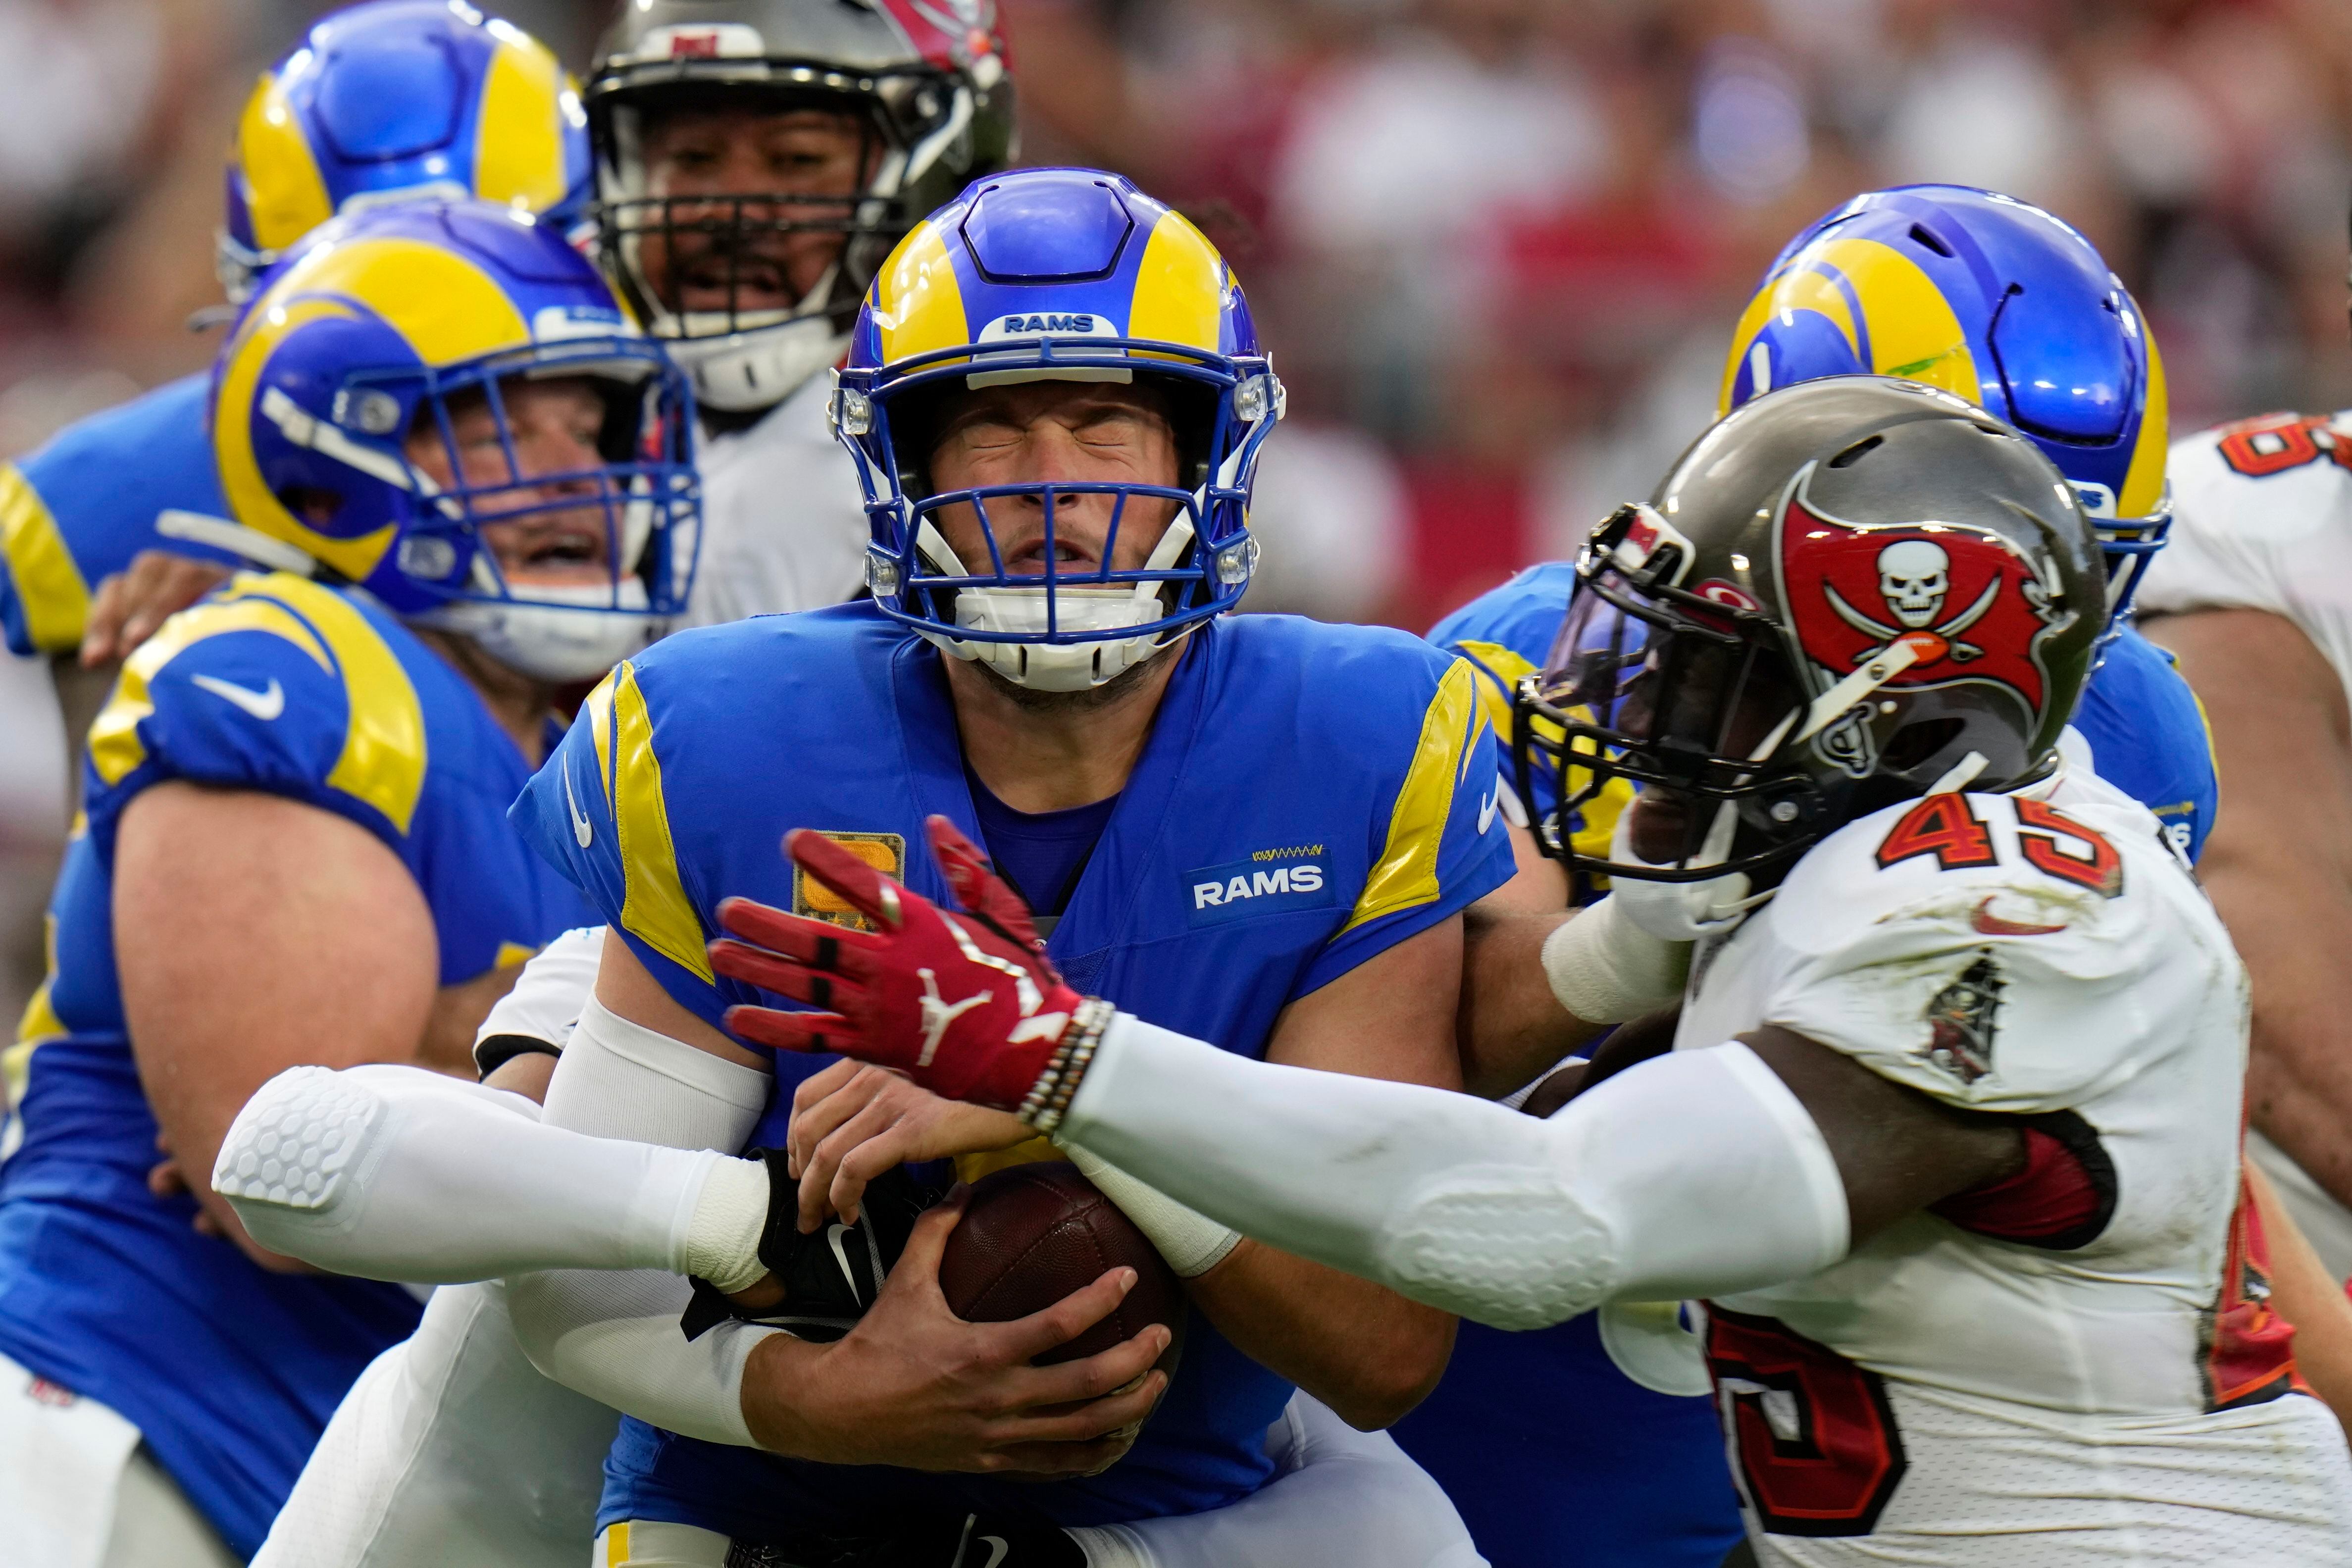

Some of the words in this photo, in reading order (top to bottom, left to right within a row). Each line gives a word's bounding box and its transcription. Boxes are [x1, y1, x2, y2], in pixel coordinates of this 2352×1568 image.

[1004, 315, 1094, 333] RAMS
[1875, 792, 2123, 899] 45
[1193, 865, 1324, 910] RAMS
[1699, 1299, 1911, 1537] 5
